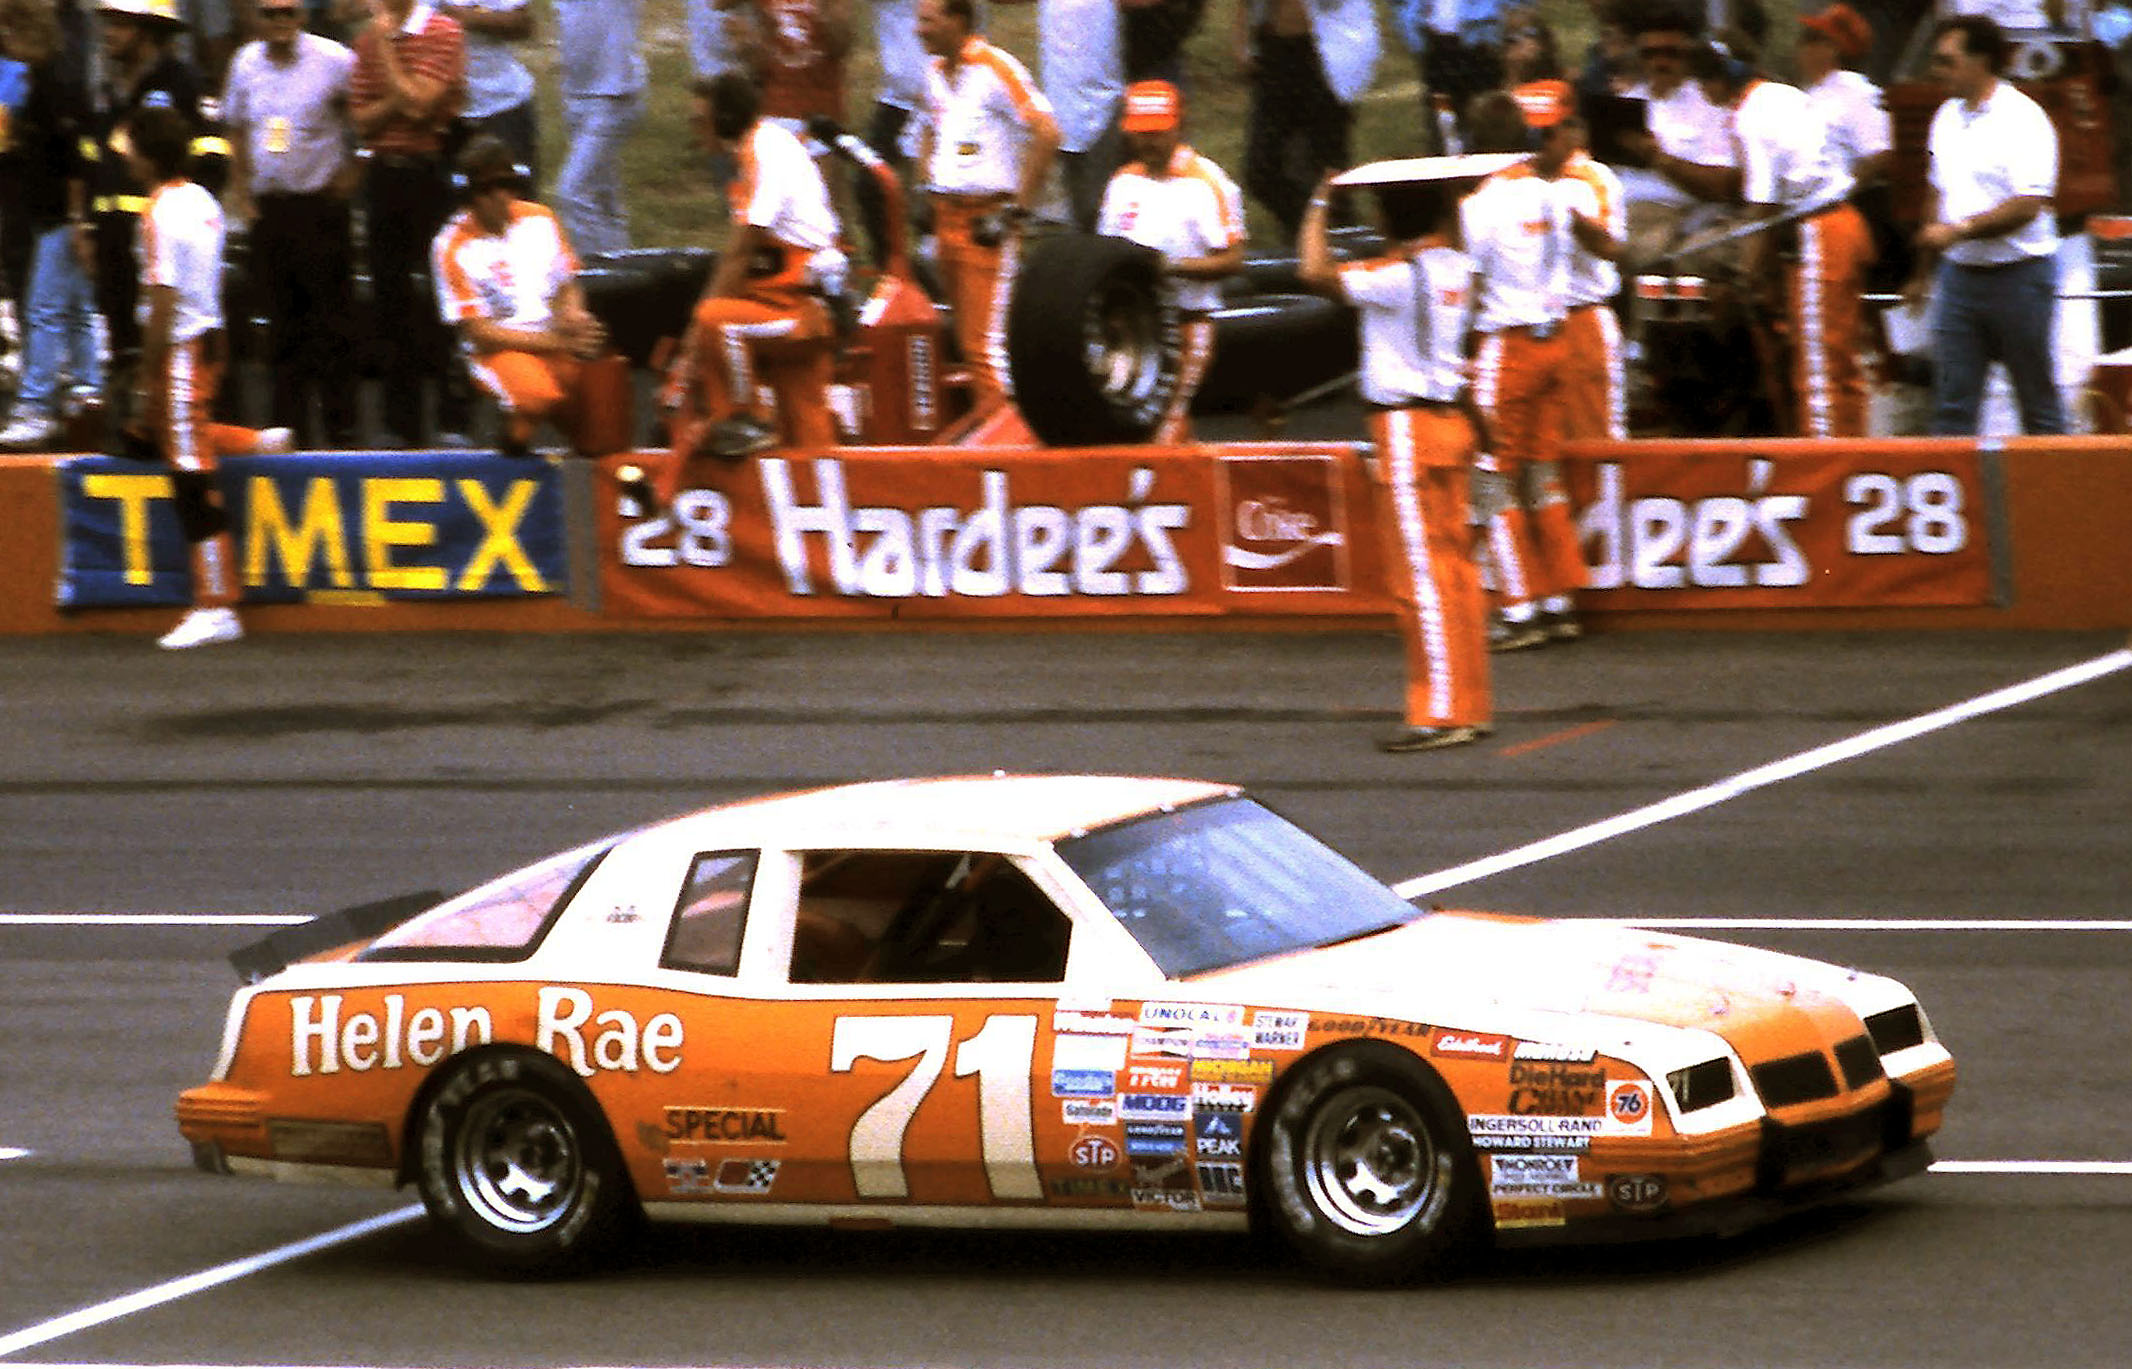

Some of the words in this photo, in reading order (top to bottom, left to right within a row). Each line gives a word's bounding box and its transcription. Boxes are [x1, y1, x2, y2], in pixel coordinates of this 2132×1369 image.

[81, 474, 548, 592] TMEX
[759, 457, 1190, 597] Hardee's
[1578, 458, 1810, 588] dee's
[1843, 471, 1968, 555] 28
[289, 994, 493, 1077] Helen
[537, 986, 684, 1077] Rae
[665, 1110, 786, 1140] SPECIAL
[829, 1014, 1044, 1198] 71
[1616, 1093, 1642, 1114] 76
[1075, 1141, 1116, 1165] STP
[1196, 1138, 1241, 1156] PEAK
[1618, 1181, 1660, 1201] STP
